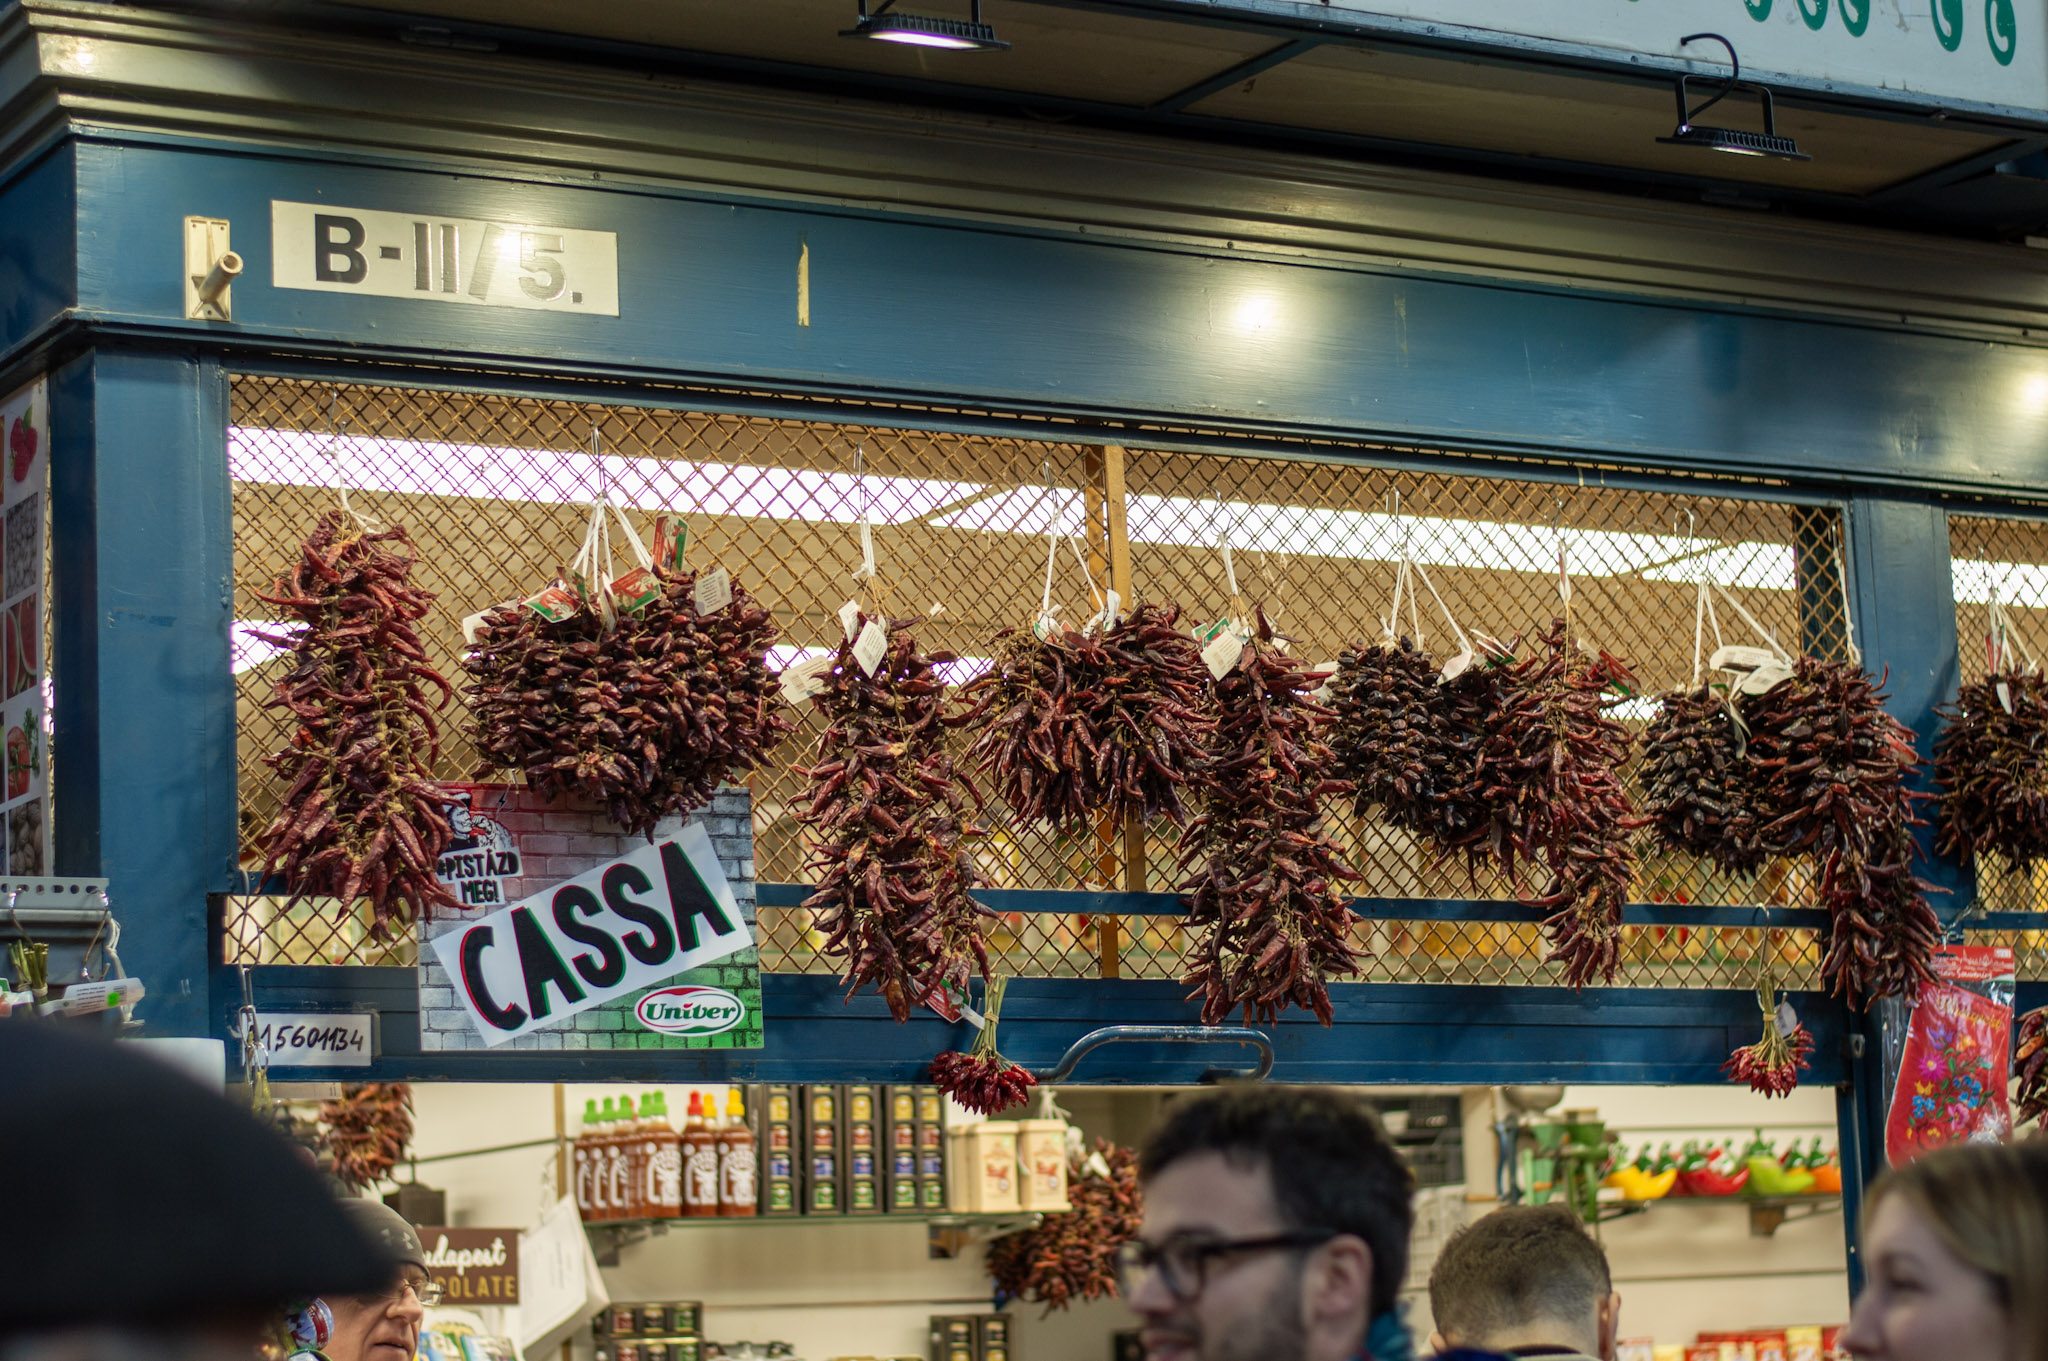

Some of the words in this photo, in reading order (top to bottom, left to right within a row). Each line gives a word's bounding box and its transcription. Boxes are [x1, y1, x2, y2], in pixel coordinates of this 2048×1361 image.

[460, 879, 500, 904] MEG!
[459, 841, 736, 1031] CASSA
[646, 1002, 737, 1021] Univer
[424, 1233, 507, 1276] udapest
